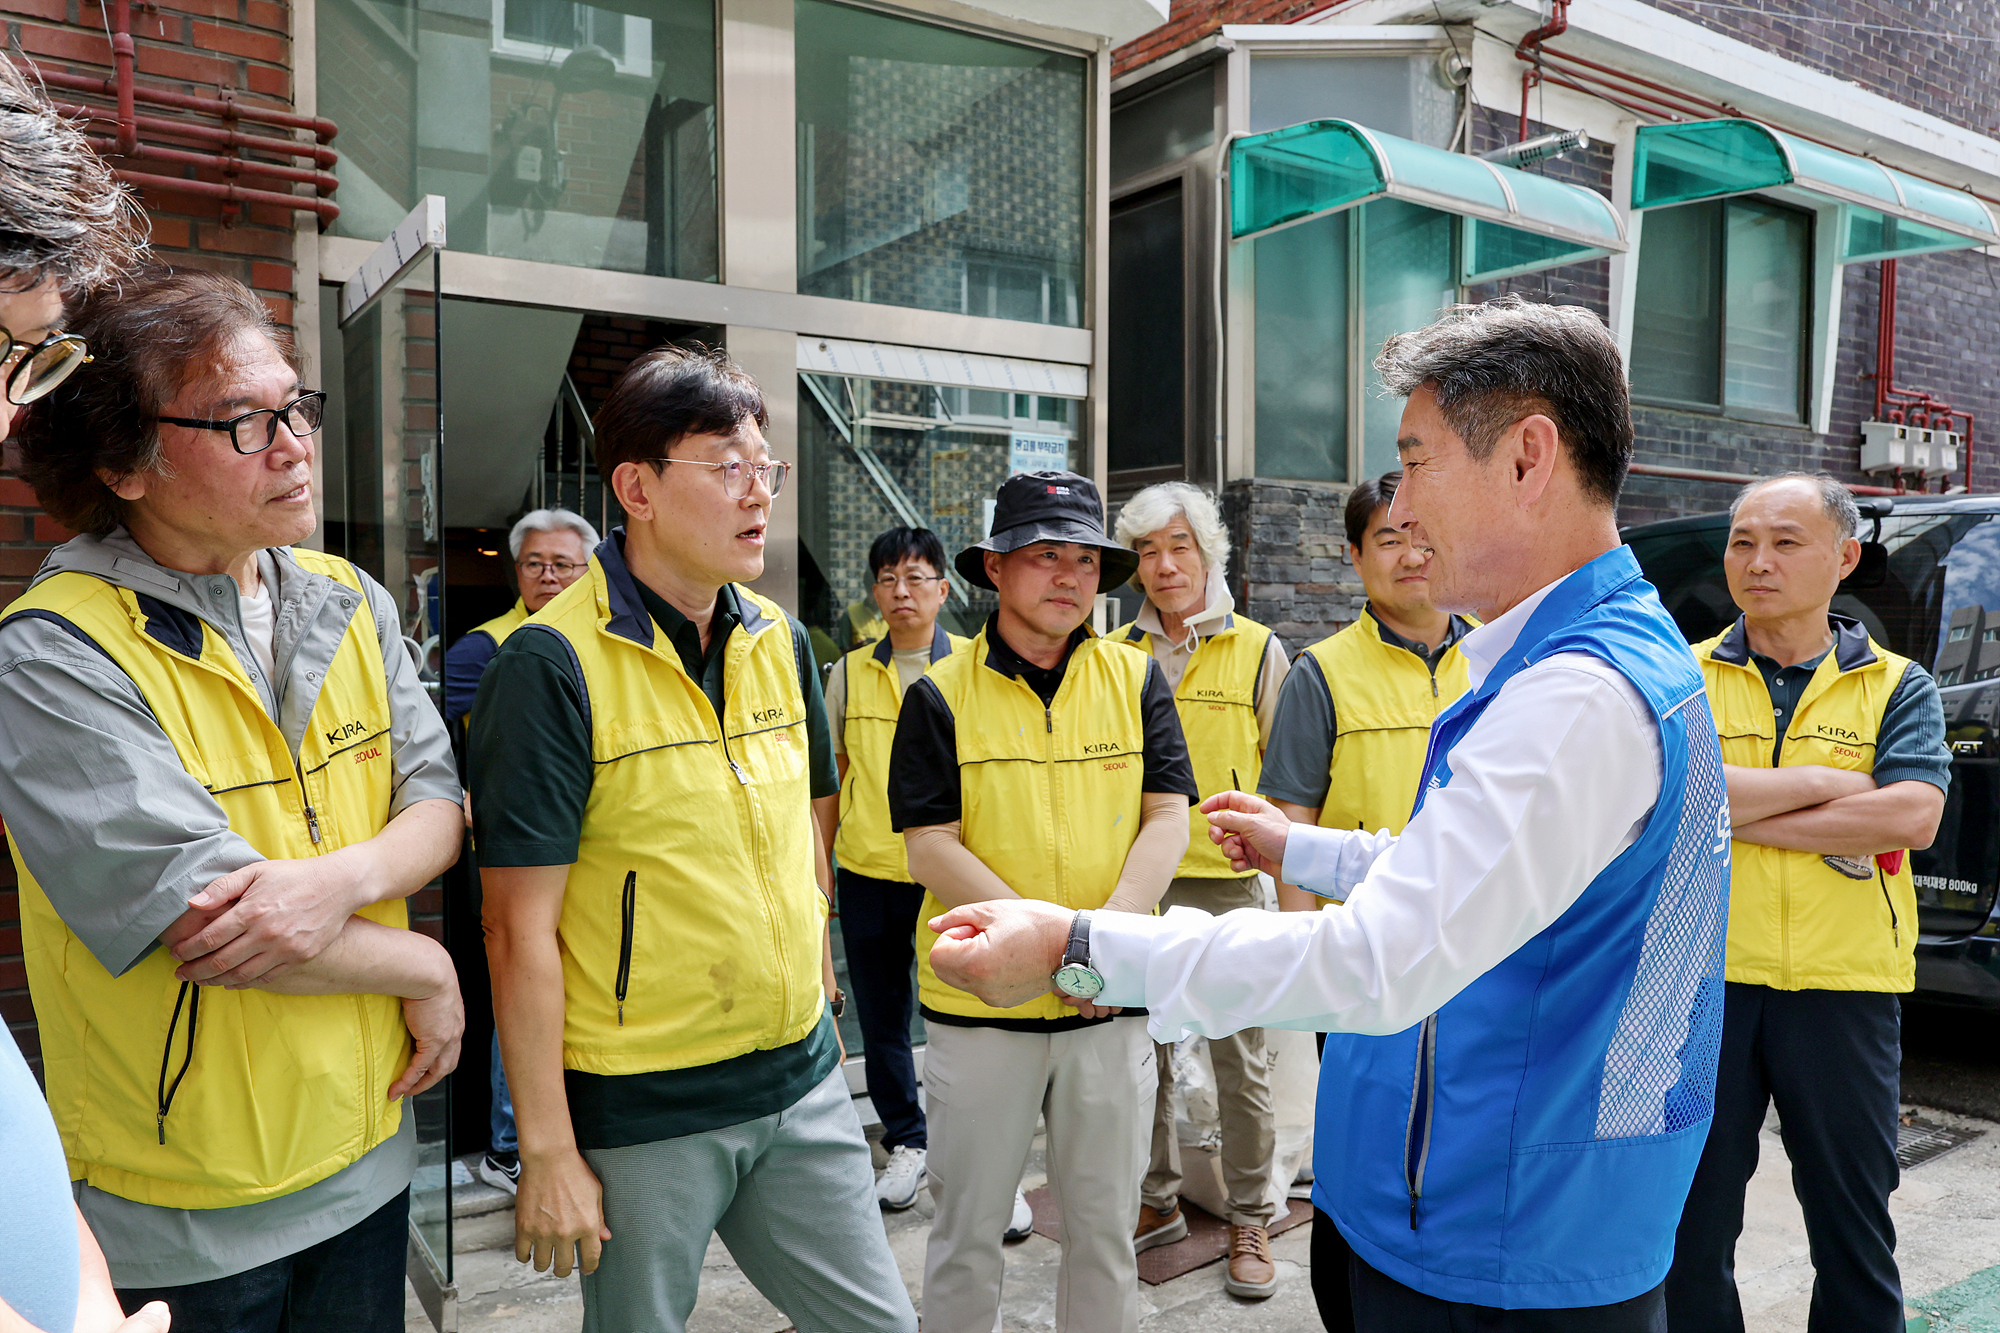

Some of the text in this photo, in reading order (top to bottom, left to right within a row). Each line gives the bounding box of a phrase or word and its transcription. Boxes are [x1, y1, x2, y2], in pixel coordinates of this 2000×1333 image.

[1037, 441, 1064, 455] 부착금지
[1196, 690, 1224, 698] KIRA
[753, 708, 784, 723] KIRA
[326, 720, 367, 745] KIRA
[1818, 725, 1859, 741] KIRA
[1084, 743, 1120, 754] KIRA
[1833, 746, 1862, 760] SEOUL
[1942, 740, 1983, 754] VGT
[1103, 762, 1128, 771] SEOUL
[1913, 874, 1978, 894] 대적재량 800kg
